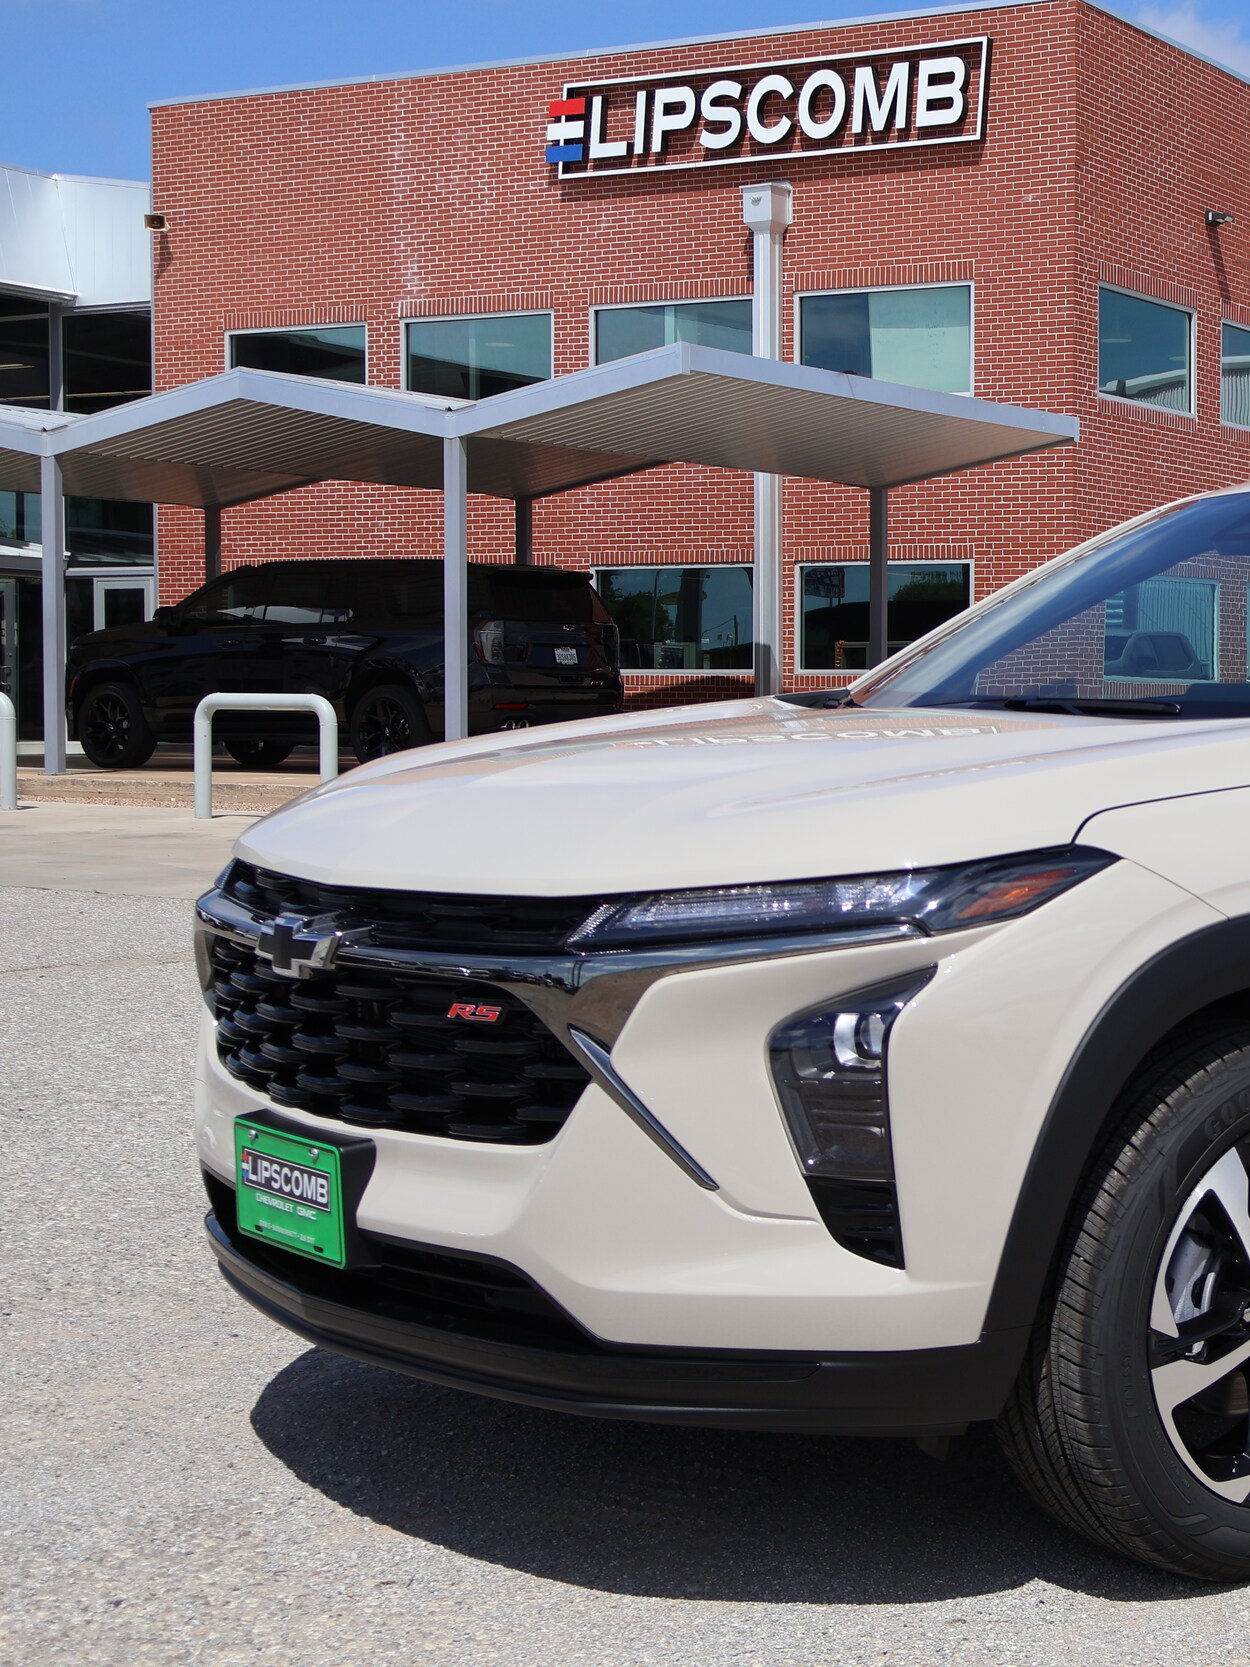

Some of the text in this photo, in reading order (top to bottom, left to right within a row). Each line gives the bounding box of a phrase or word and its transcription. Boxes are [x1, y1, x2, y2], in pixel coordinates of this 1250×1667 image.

[590, 56, 968, 159] LIPSCOMB
[447, 1002, 502, 1022] RS
[249, 1155, 328, 1204] LIPSCOMB
[255, 1192, 317, 1220] CHEVROLET GMC
